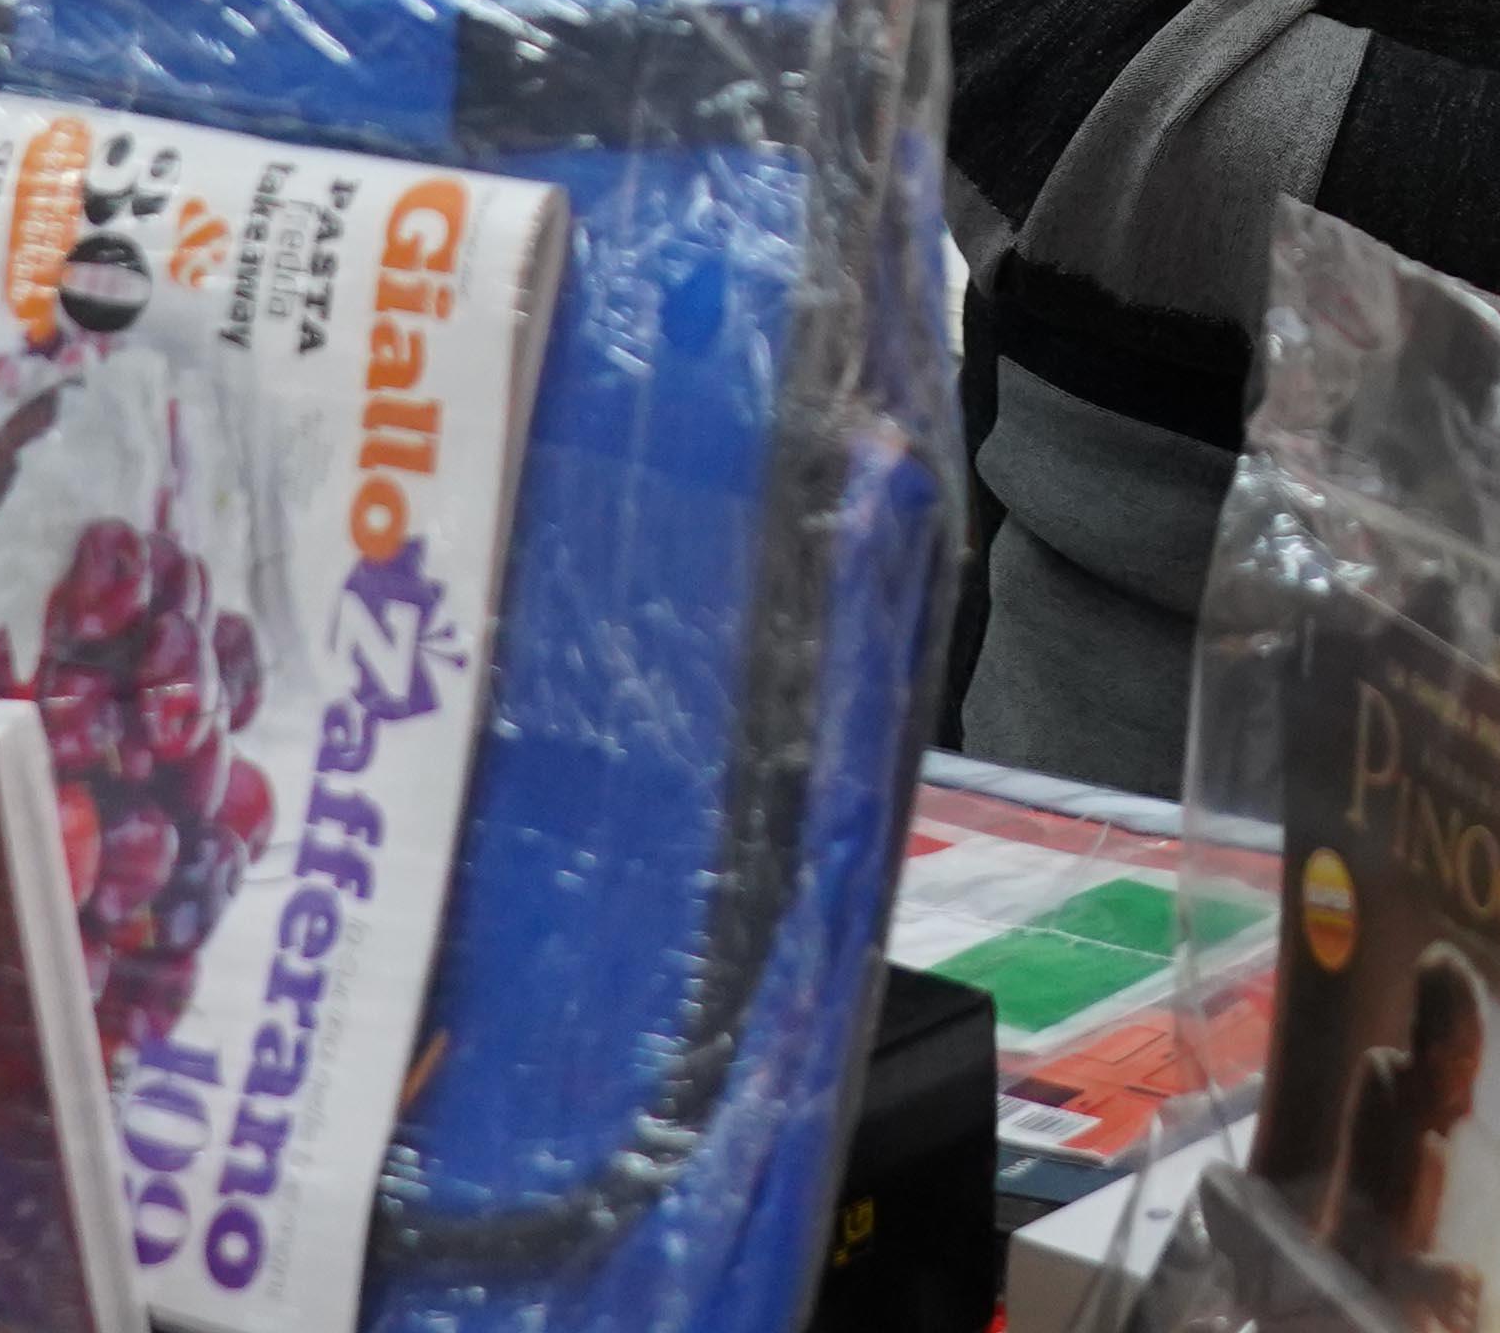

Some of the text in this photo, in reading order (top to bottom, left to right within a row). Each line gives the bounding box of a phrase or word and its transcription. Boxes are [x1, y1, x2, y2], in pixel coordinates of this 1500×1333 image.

[219, 160, 295, 351] takeaway
[267, 203, 314, 318] fredda
[299, 175, 361, 355] PASTA
[351, 175, 470, 561] Giallo
[204, 583, 440, 1293] Zafferano
